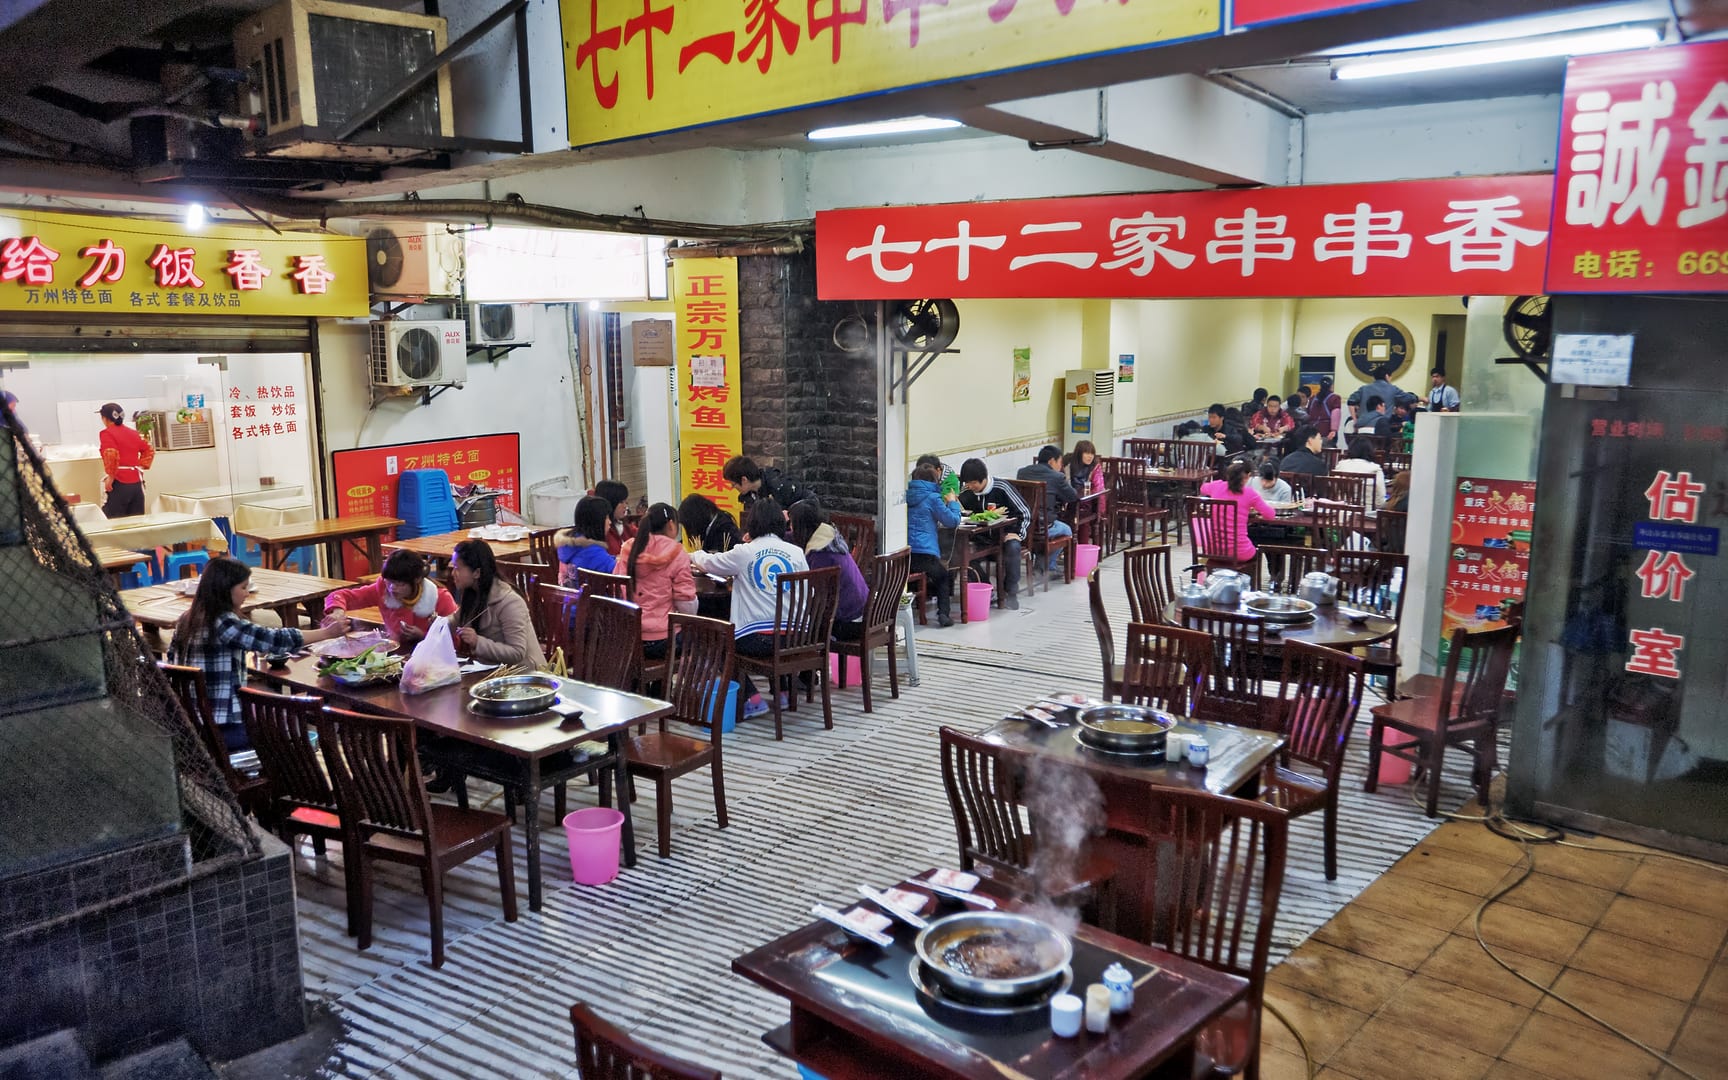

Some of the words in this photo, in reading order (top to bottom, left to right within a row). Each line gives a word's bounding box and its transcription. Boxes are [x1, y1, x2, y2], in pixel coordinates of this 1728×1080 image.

[846, 195, 1549, 283] 七十二家串串香
[0, 236, 335, 295] 给力饭香香
[25, 289, 113, 305] 万州特色面
[685, 275, 732, 428] 正宗万烤鱼
[229, 385, 295, 400] 冷、热饮品
[230, 404, 256, 418] 套饭
[271, 403, 297, 416] 炒饭
[232, 420, 297, 440] 各式特色面
[404, 449, 480, 470] 万州特色面
[1625, 470, 1706, 679] 估价室
